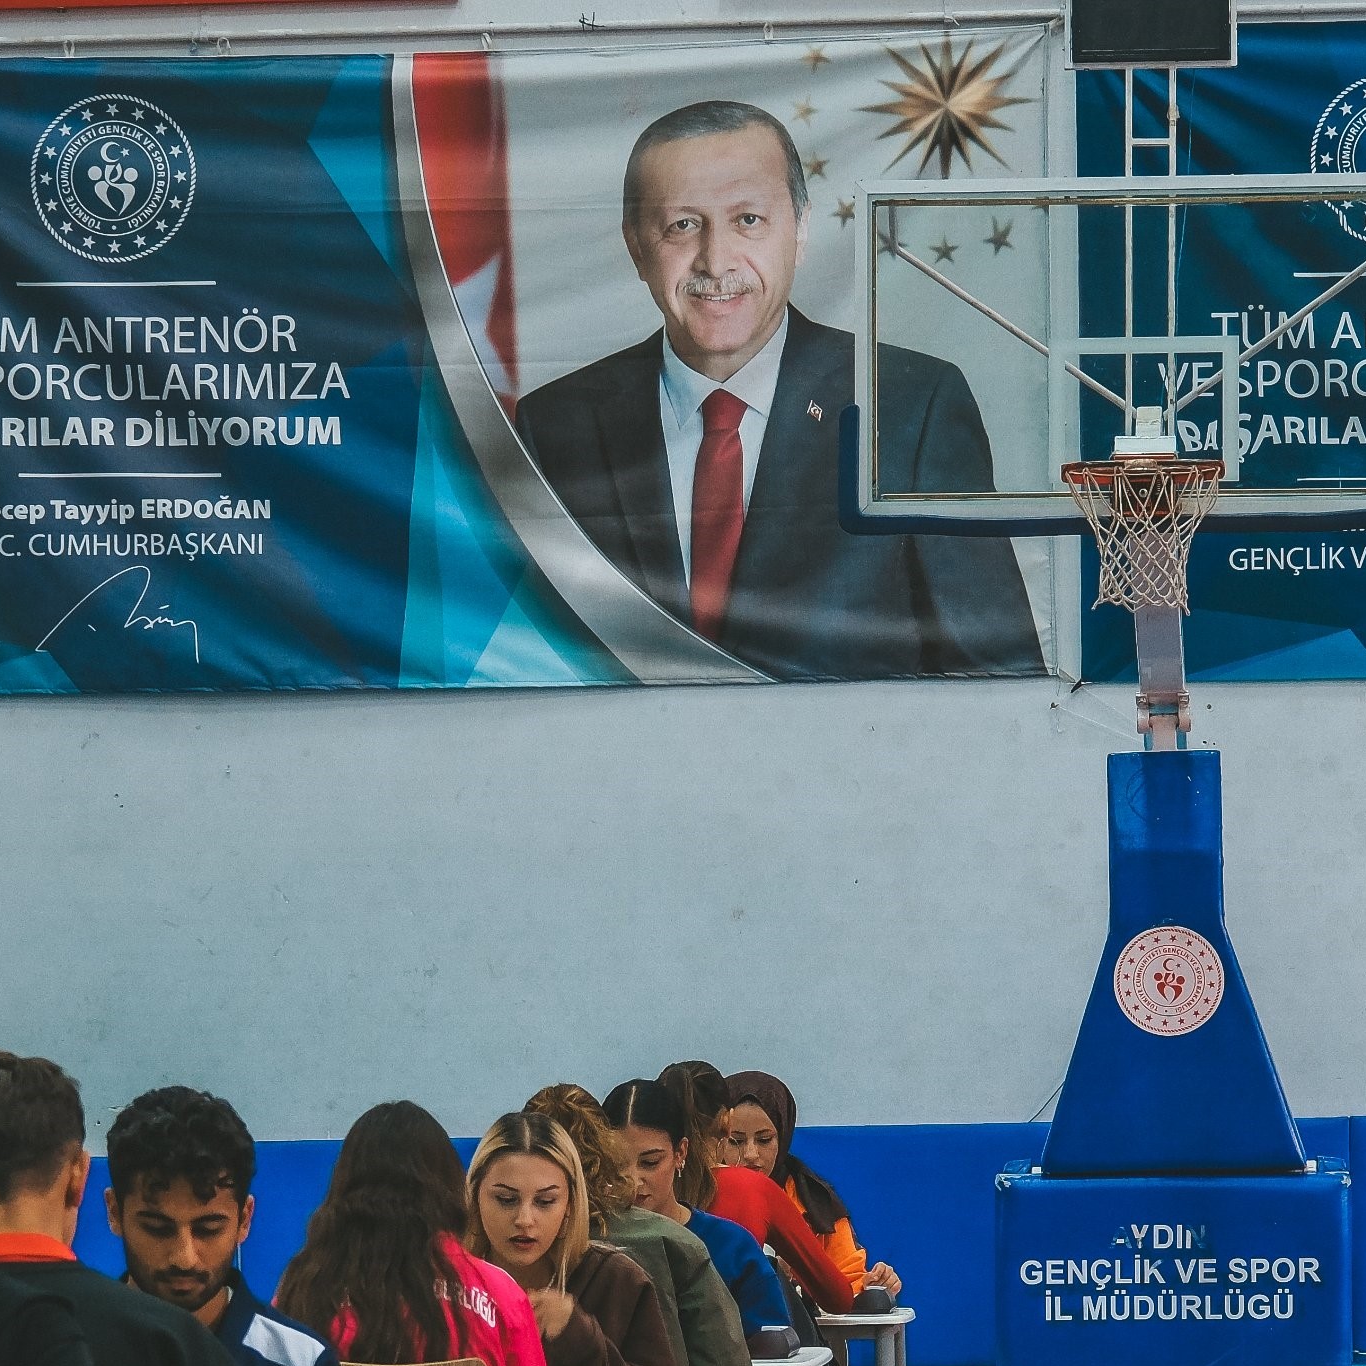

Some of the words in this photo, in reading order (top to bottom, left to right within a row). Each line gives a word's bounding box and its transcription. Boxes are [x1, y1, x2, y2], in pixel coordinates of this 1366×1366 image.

[98, 125, 144, 142] GENÇLİK
[143, 136, 156, 151] VE
[61, 128, 96, 194] CUMHURİYETİ
[151, 150, 165, 177] SPOR
[65, 196, 101, 230] TÜRKİYE
[127, 180, 165, 229] BAKANLIĞI
[54, 307, 297, 354] ANTRENÖR
[1211, 304, 1316, 350] TÜM
[1158, 362, 1215, 398] VE
[125, 410, 341, 447] DİLİYORUM
[50, 498, 135, 525] Tayyip
[141, 495, 271, 519] ERDOĞAN
[28, 532, 264, 561] CUMHURBAŞKANI
[1228, 543, 1345, 576] GENÇLİK
[1019, 1253, 1163, 1290] GENÇLİK
[1175, 1258, 1218, 1284] VE
[1228, 1257, 1322, 1283] SPOR
[1044, 1289, 1073, 1321] İL
[1083, 1288, 1295, 1321] MÜDÜRLÜGÜ
